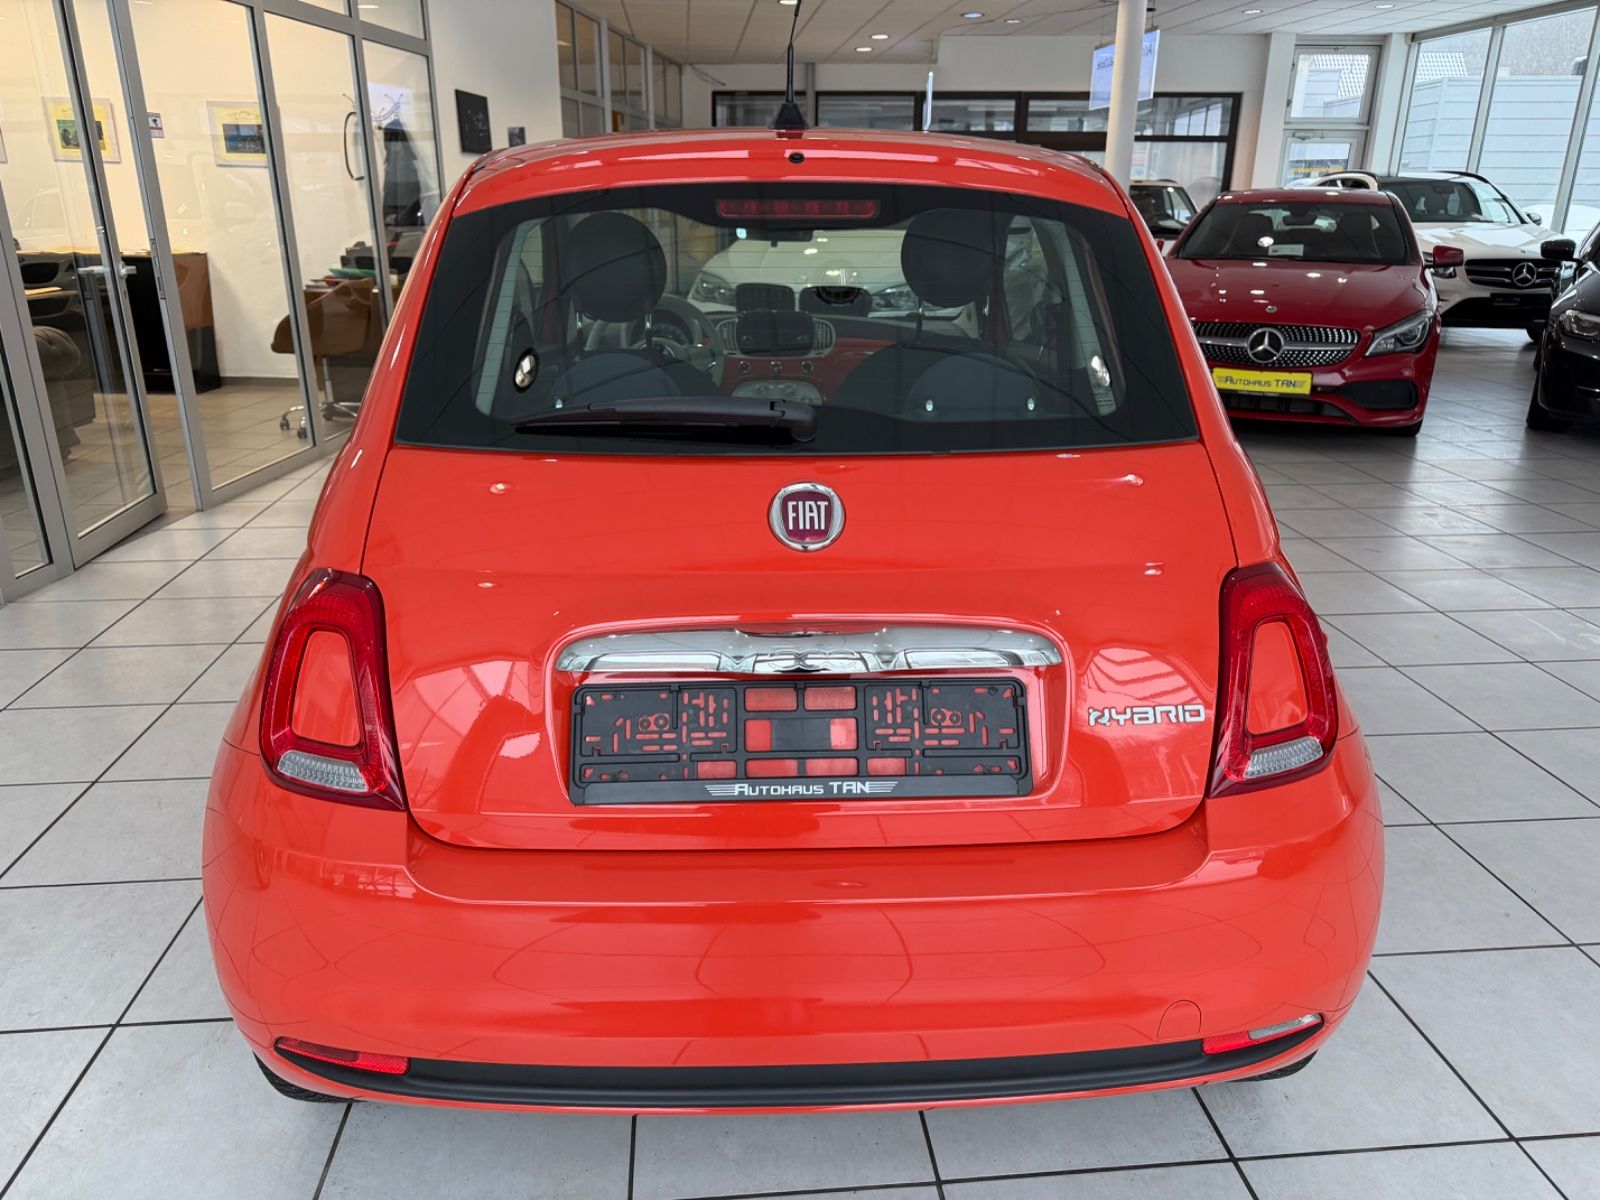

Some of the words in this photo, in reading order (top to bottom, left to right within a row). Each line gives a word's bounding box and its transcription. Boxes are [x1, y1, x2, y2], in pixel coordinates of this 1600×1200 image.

[1274, 378, 1296, 388] TAN
[787, 501, 828, 530] FIAT
[1088, 704, 1205, 726] HYBRID
[829, 781, 870, 794] TAN
